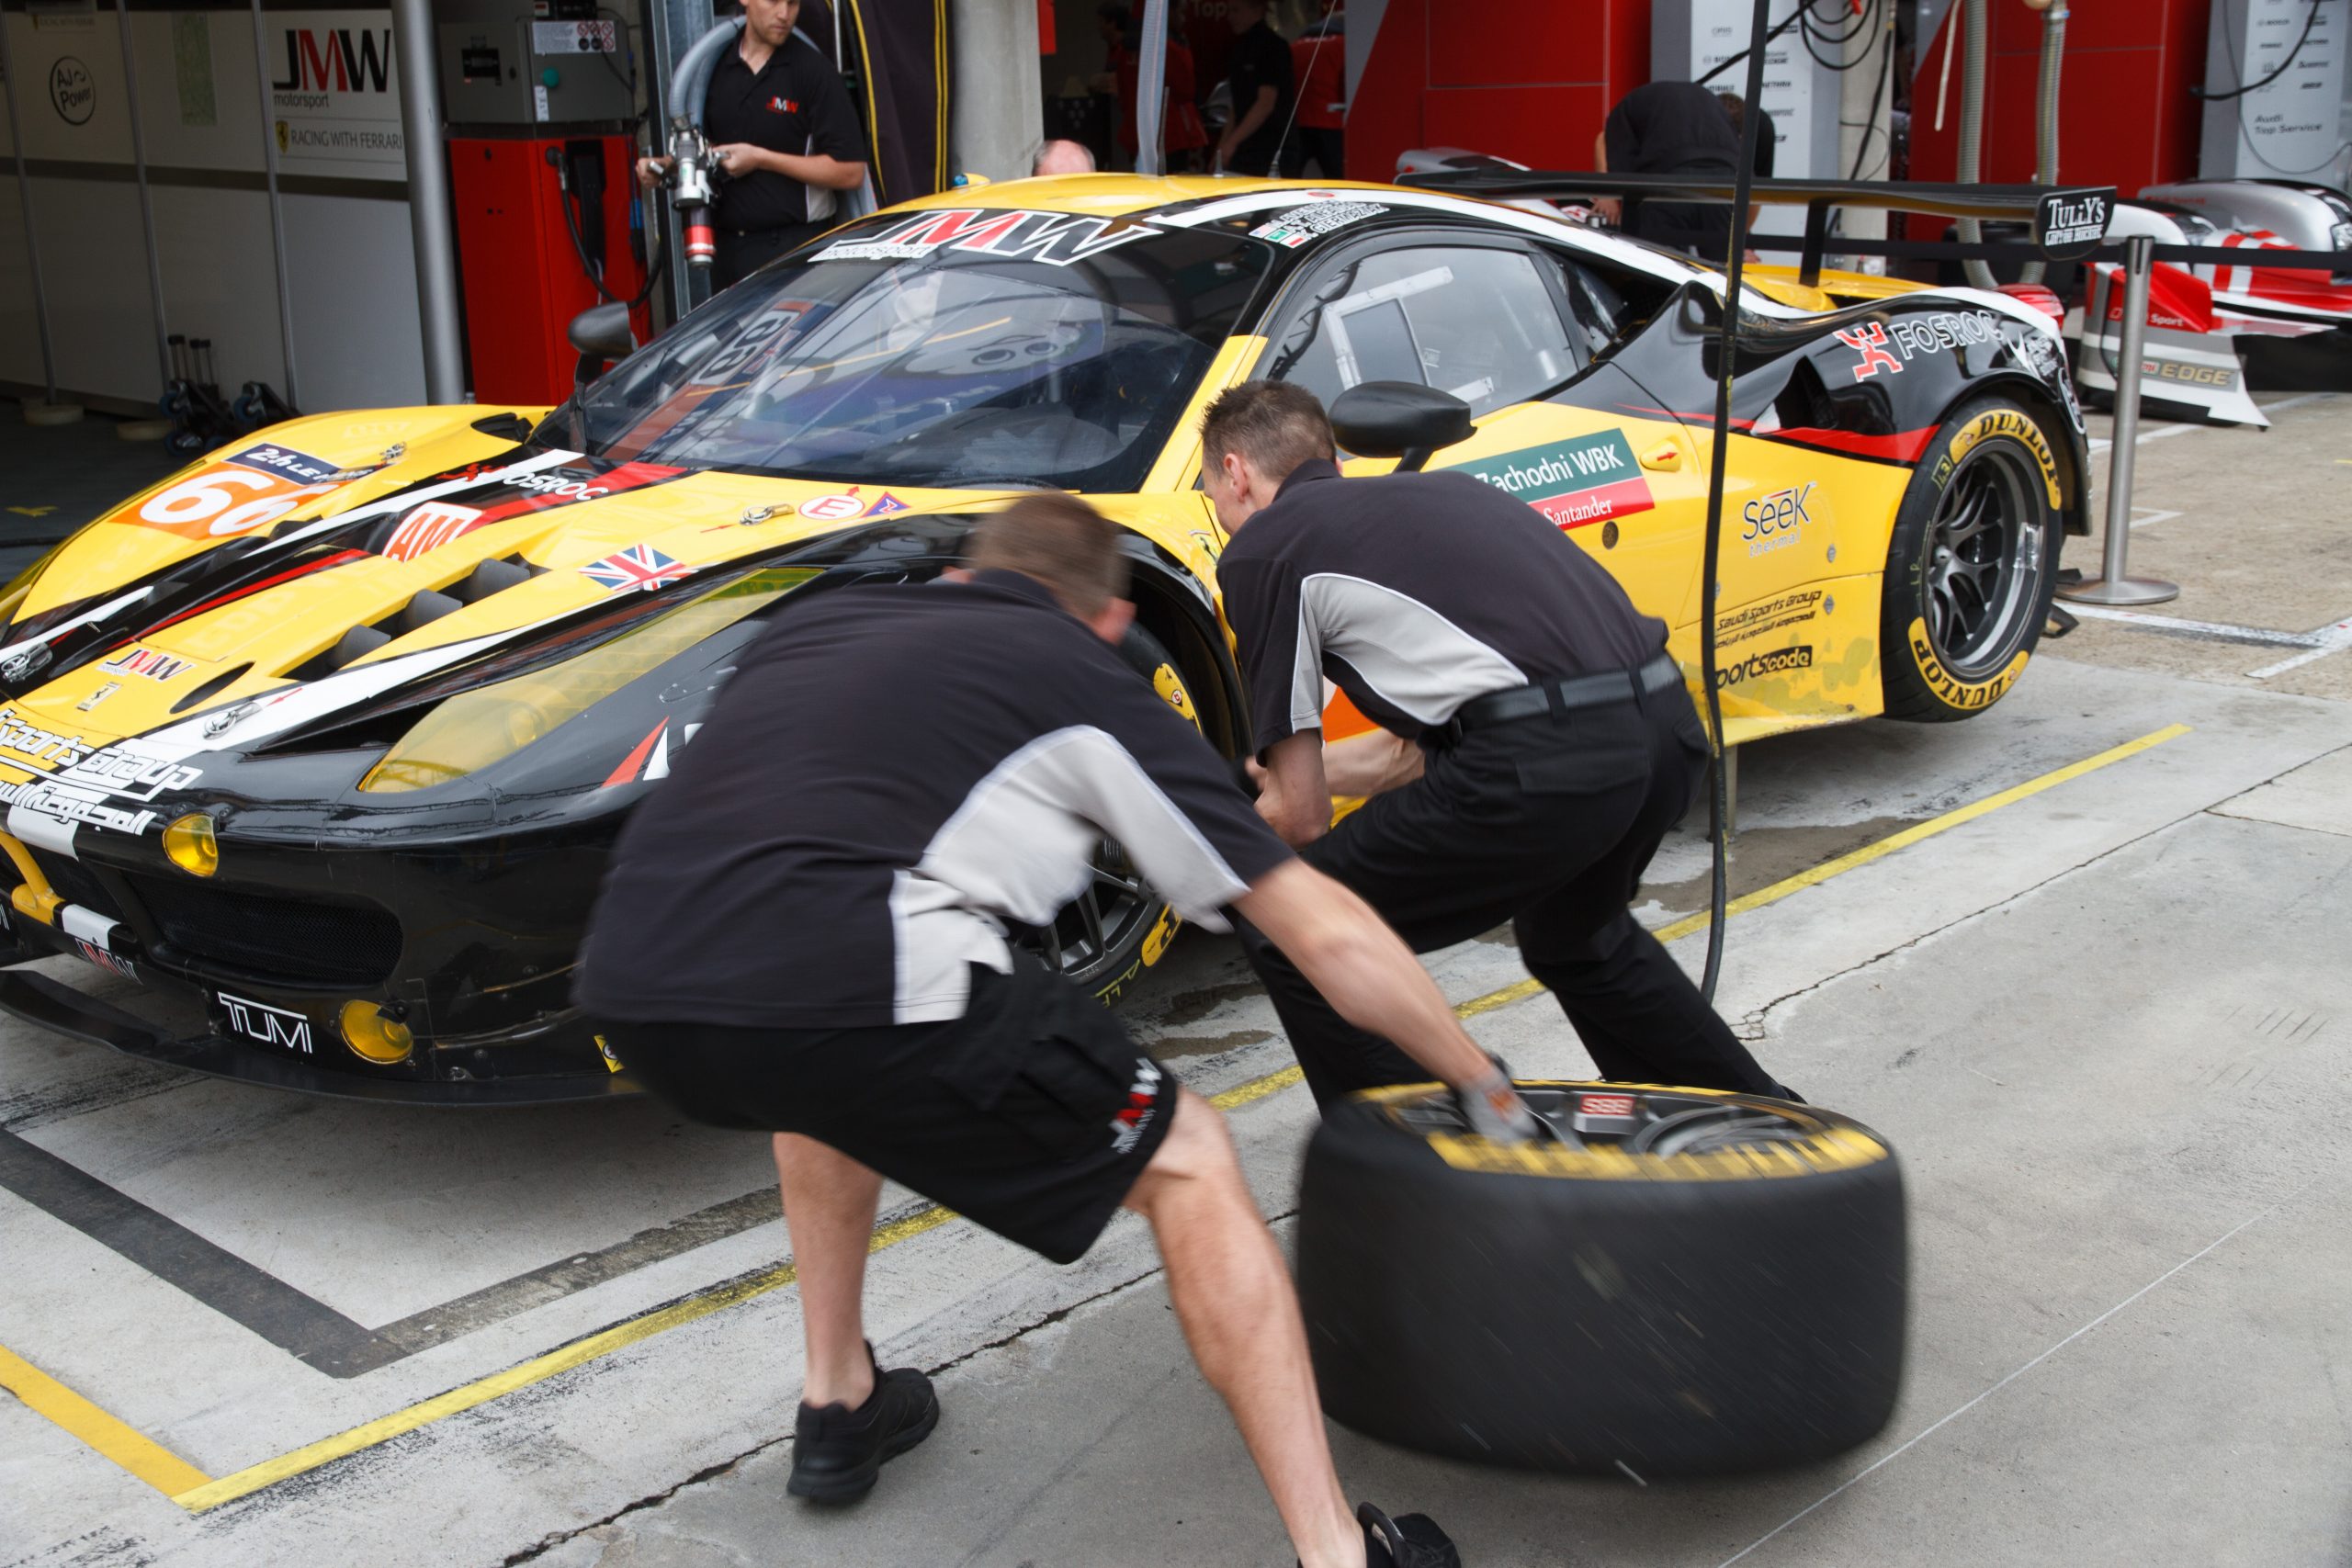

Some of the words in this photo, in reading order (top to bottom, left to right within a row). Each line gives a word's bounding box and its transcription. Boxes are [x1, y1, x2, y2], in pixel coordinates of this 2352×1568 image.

[273, 29, 390, 93] JMW
[57, 68, 73, 87] AJ
[60, 87, 91, 111] Power
[274, 94, 329, 108] motorsport
[766, 95, 799, 114] JMW
[2255, 114, 2283, 123] Audi
[2255, 126, 2277, 135] Top
[2278, 124, 2323, 133] Service
[291, 130, 328, 146] RACING
[331, 132, 358, 147] WITH
[360, 133, 402, 150] FERRARI
[827, 209, 1164, 266] JMW
[1889, 310, 2005, 360] FOSROC
[2151, 313, 2185, 327] Sport
[2161, 363, 2231, 386] EDGE
[1569, 443, 1624, 476] WBK
[1977, 412, 2059, 488] DUNLOP
[502, 472, 609, 501] OSROC
[140, 470, 340, 536] 66
[1544, 495, 1612, 526] Santander
[384, 512, 467, 563] AM
[1749, 528, 1801, 558] thermal
[103, 649, 196, 682] JMW
[1714, 646, 1813, 689] portscode
[1914, 639, 2004, 706] DUNLOP
[74, 937, 143, 986] JMW
[218, 991, 312, 1055] TUMI
